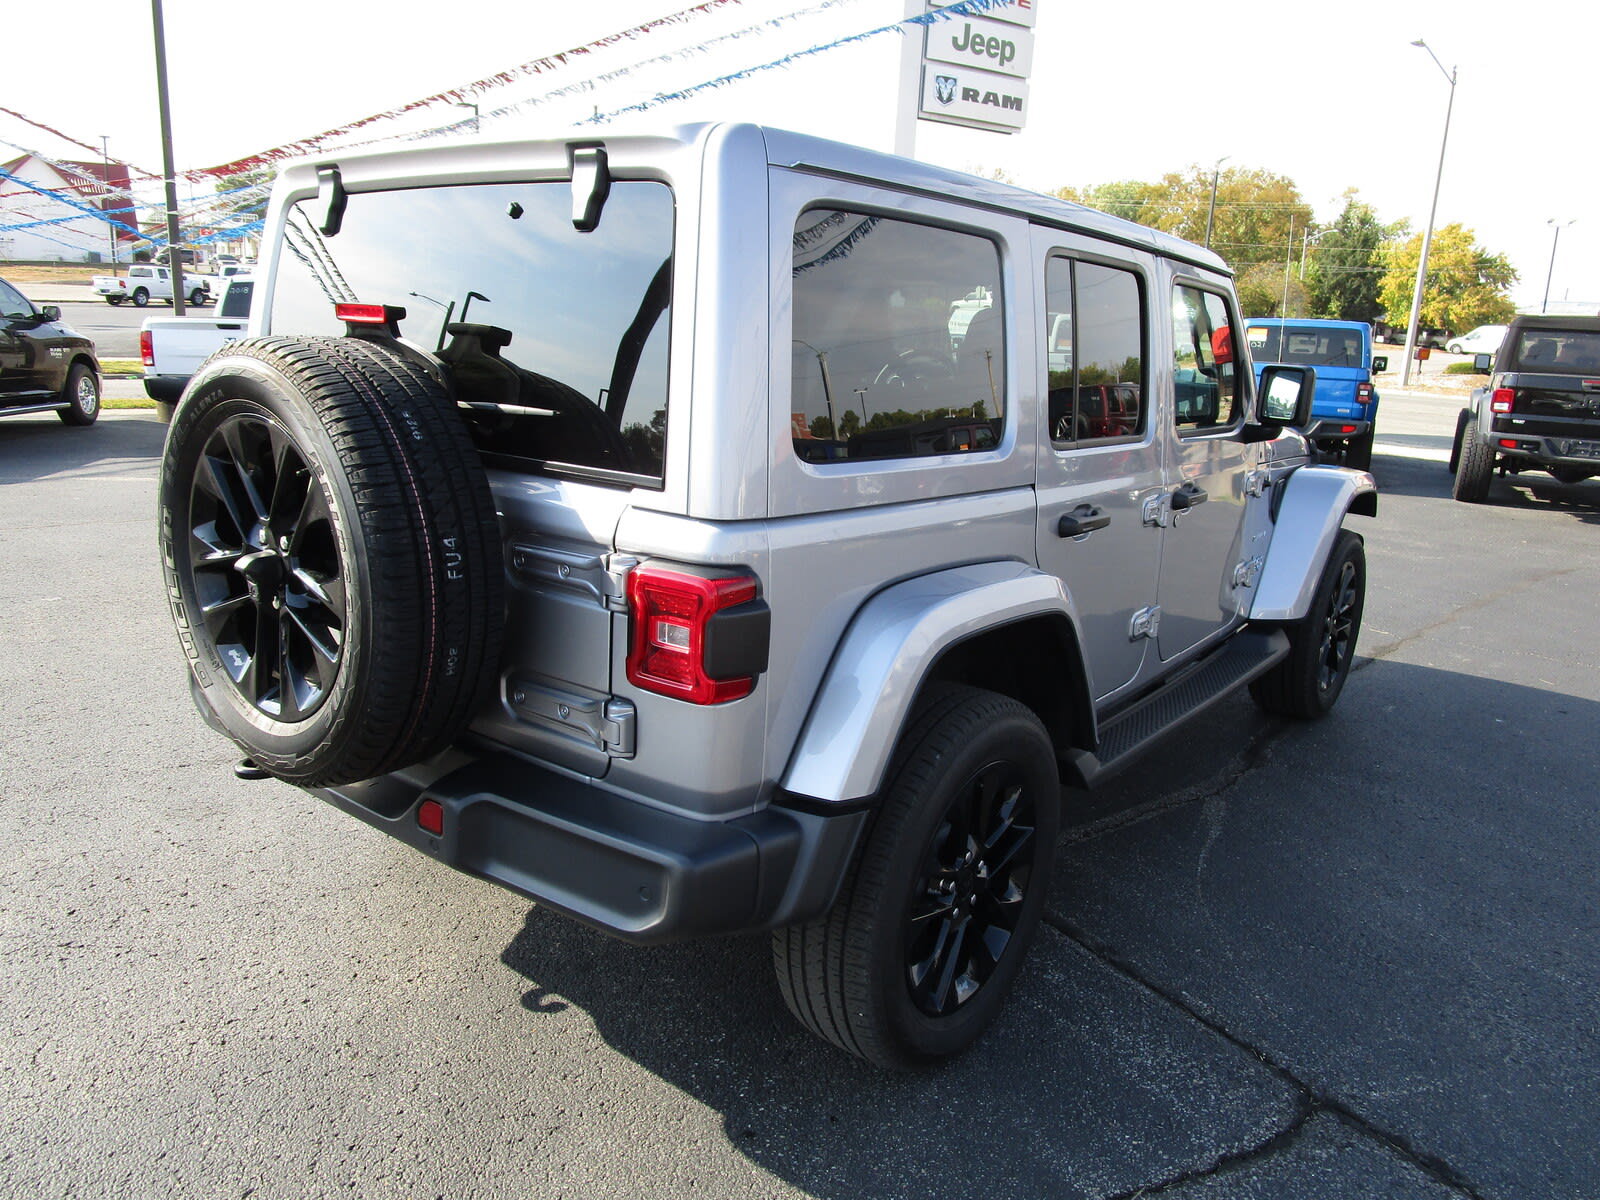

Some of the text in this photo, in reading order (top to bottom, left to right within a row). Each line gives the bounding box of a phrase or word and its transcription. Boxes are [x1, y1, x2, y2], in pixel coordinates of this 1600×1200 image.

[951, 23, 1015, 66] Jeep
[961, 86, 1023, 111] RAM
[190, 389, 225, 420] ALENZA
